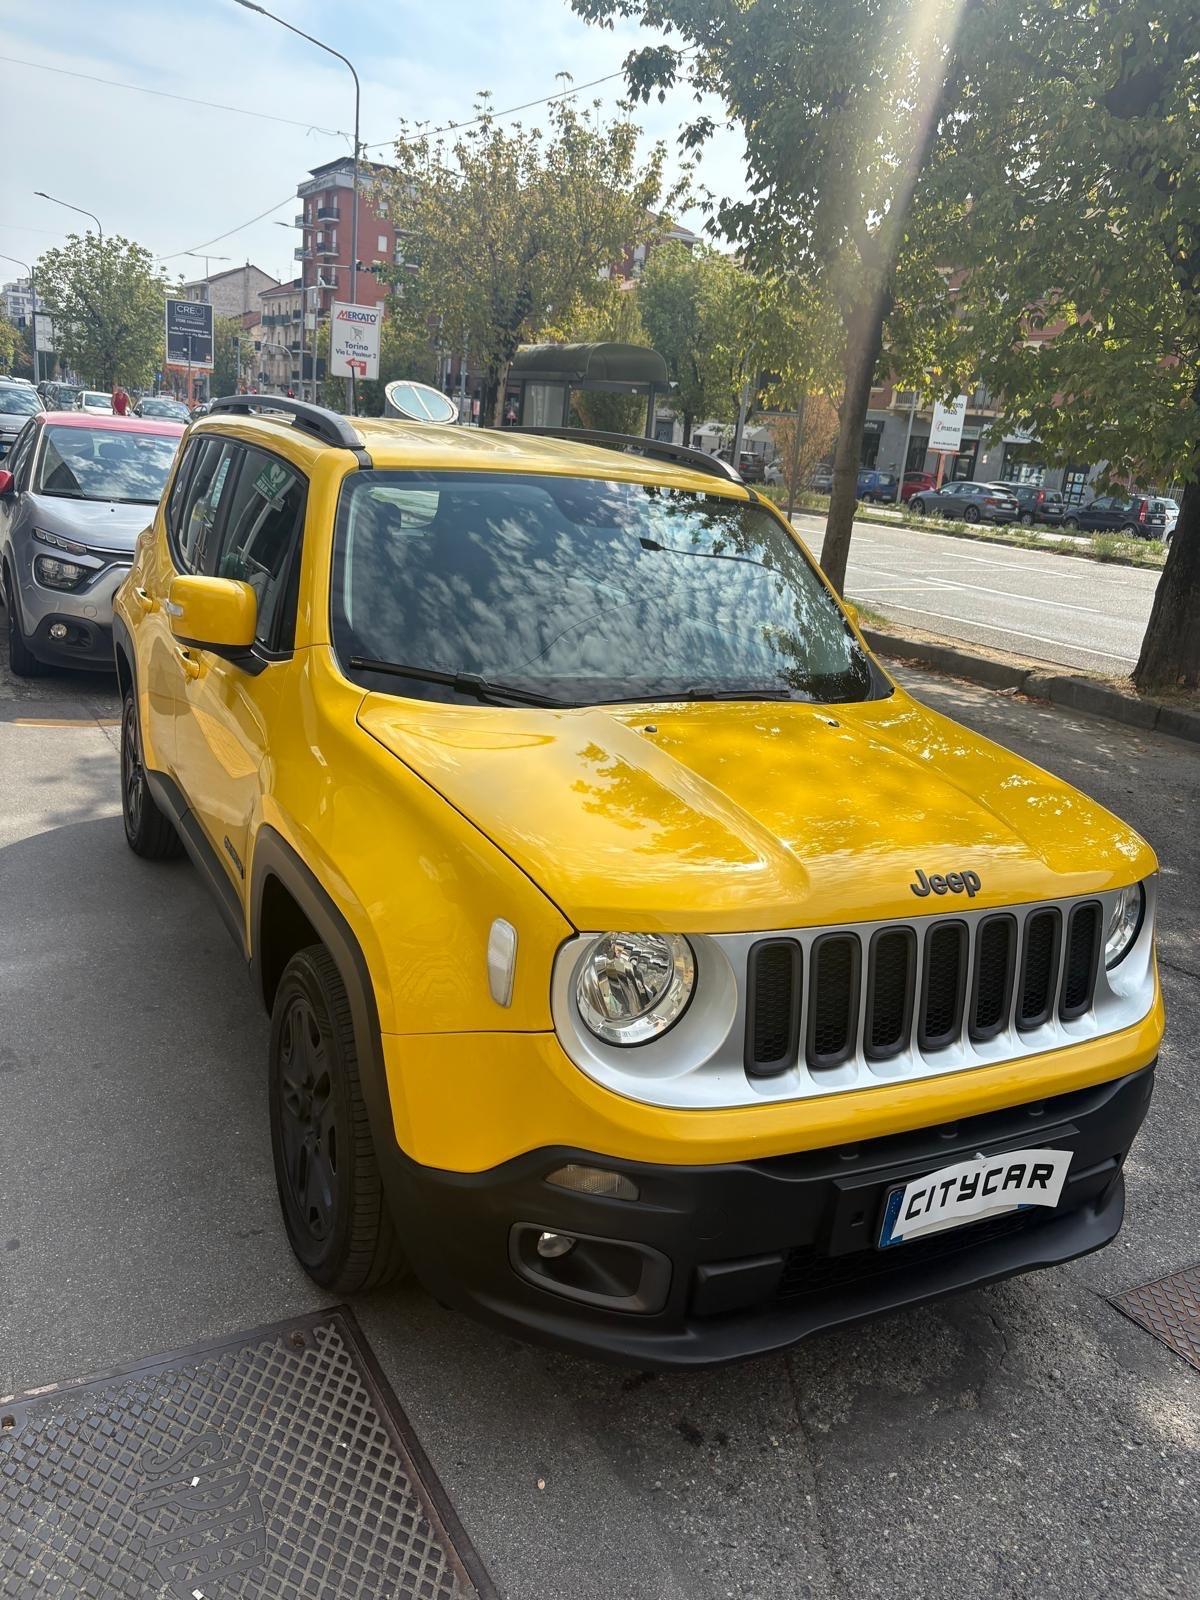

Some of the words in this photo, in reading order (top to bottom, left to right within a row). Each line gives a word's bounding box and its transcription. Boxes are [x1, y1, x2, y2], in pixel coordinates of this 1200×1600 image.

[345, 341, 368, 351] Torino
[910, 869, 981, 897] Jeep
[905, 1164, 1054, 1221] CITYCAR
